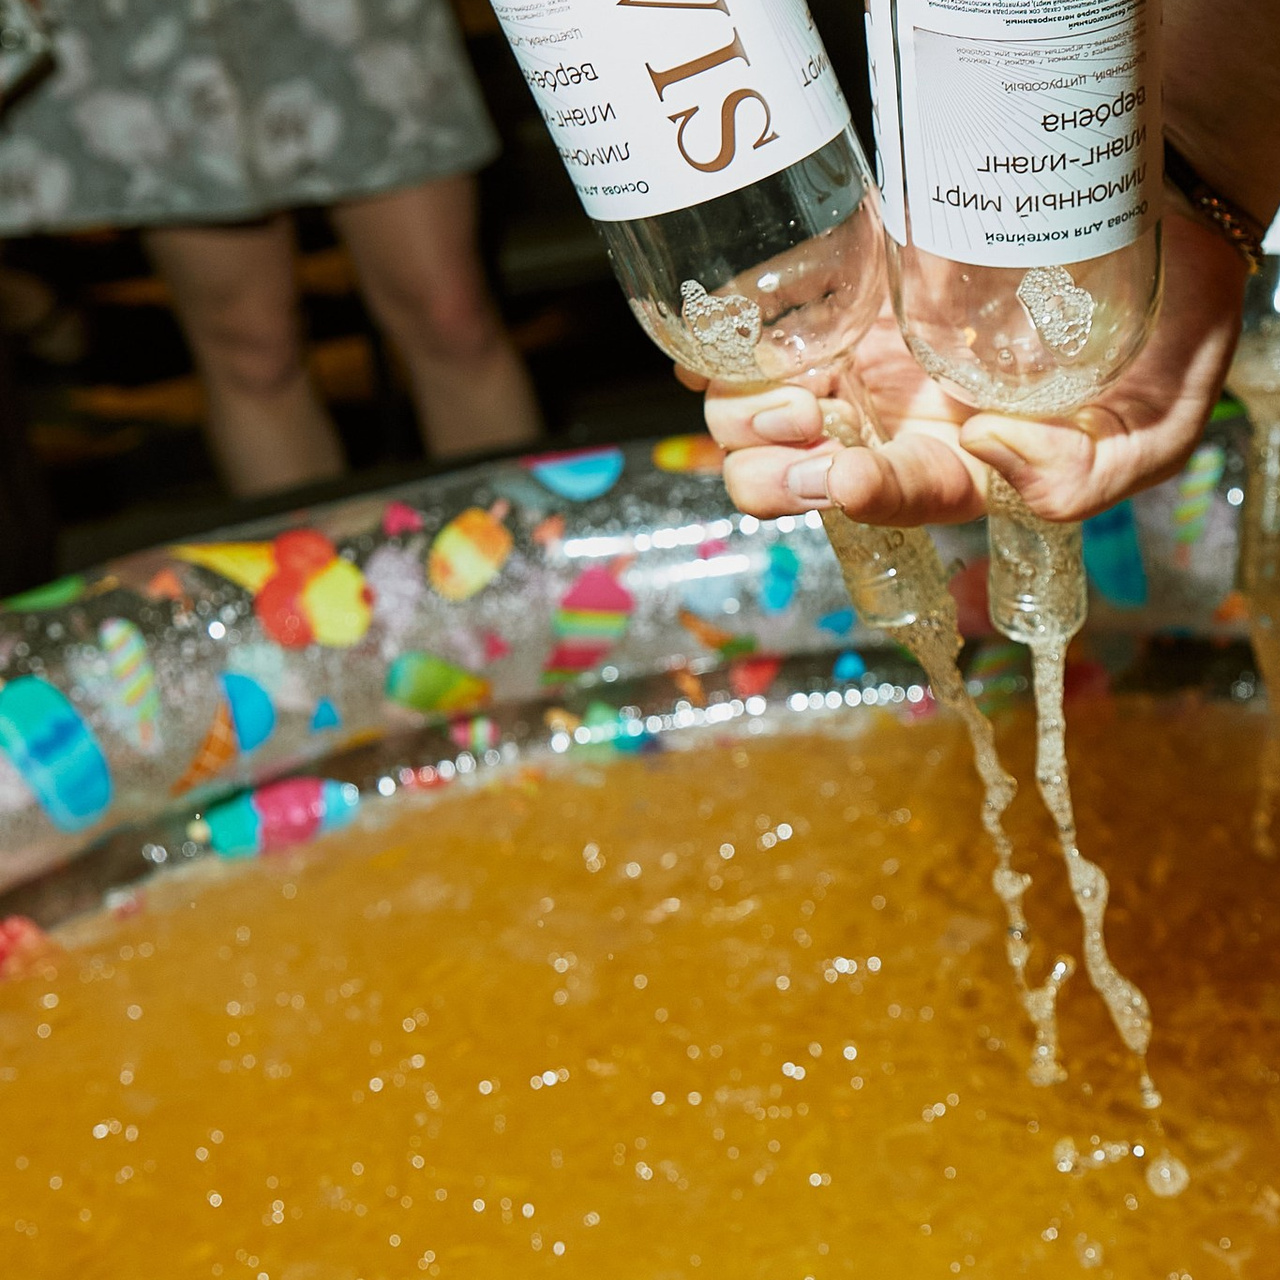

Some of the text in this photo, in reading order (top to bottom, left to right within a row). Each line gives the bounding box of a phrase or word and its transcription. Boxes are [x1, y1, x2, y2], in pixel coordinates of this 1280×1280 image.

[992, 0, 1030, 9] регуляторы
[992, 8, 1027, 16] винограда
[1002, 9, 1100, 27] сырье негазированный.
[1001, 74, 1087, 94] цитрусовый,
[1040, 85, 1146, 133] вербена
[977, 124, 1147, 174] иланг-иланг
[601, 180, 650, 196] Основа
[932, 162, 1147, 218] лимонный мирт
[984, 199, 1148, 246] Основа для коктейлей
